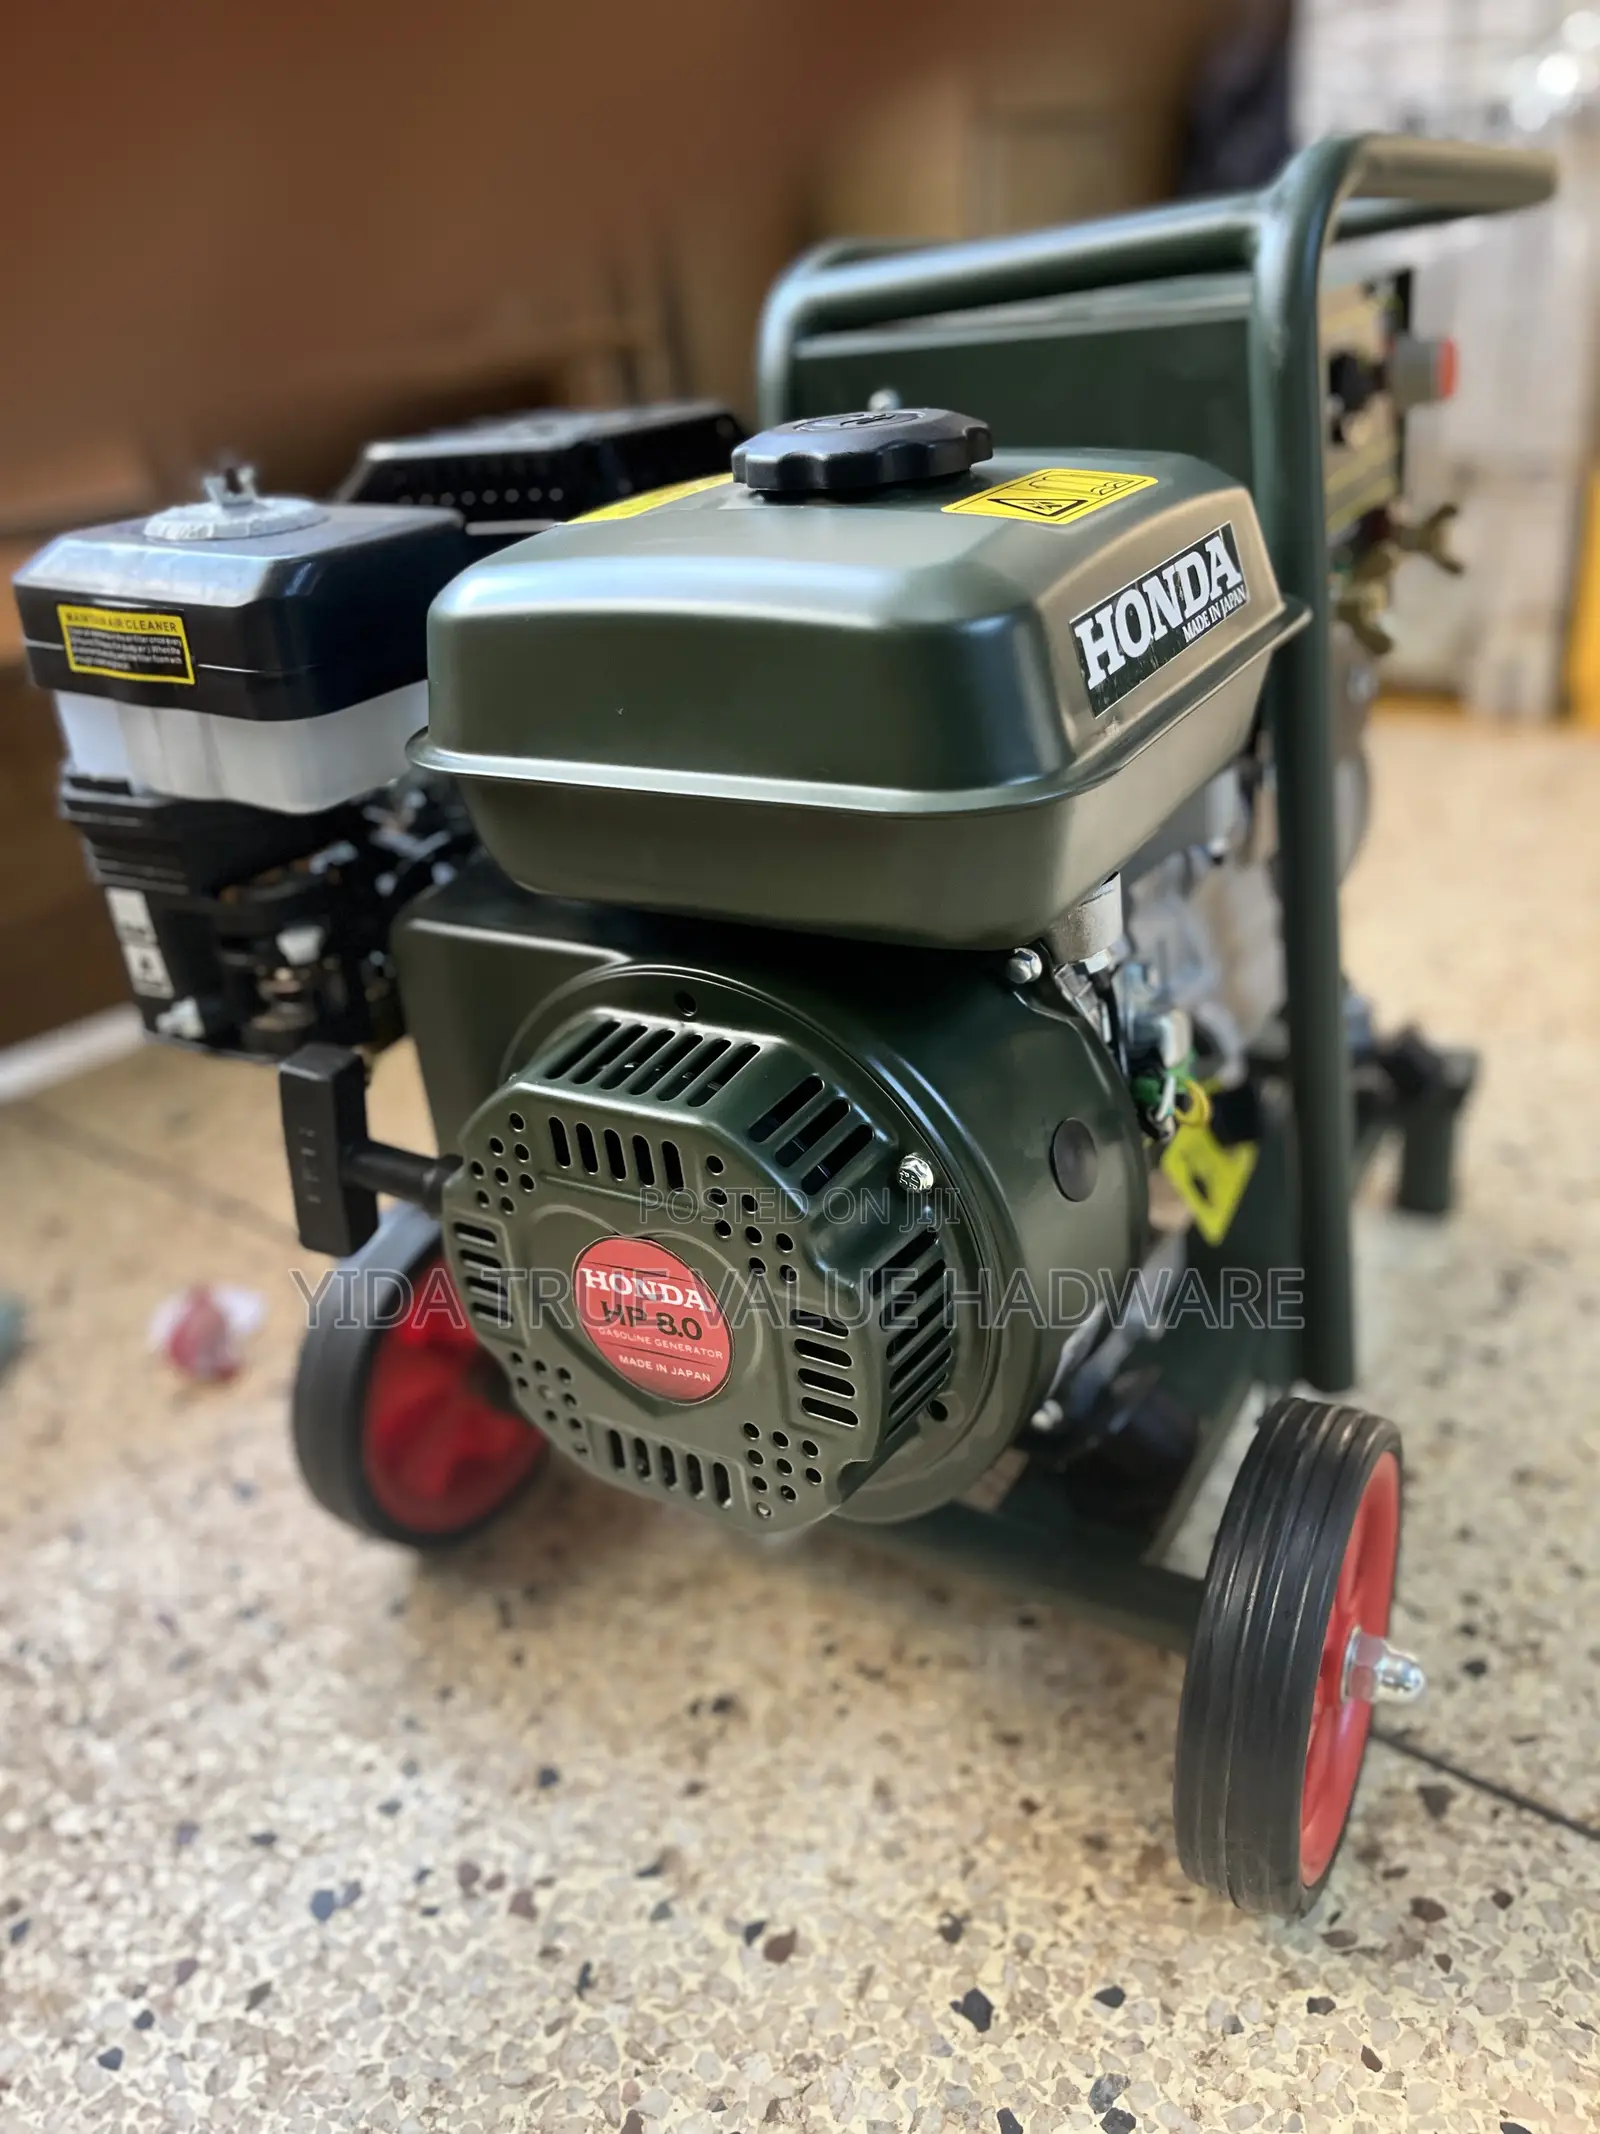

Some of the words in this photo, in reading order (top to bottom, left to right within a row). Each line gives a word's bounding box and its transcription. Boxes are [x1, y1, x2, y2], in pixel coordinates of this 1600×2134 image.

[125, 619, 178, 633] CLEANER
[1074, 535, 1243, 691] HONDA
[1181, 617, 1209, 642] MADE
[1208, 604, 1222, 624] IN
[1219, 585, 1247, 618] JAPAN
[580, 1267, 712, 1313] HONDA
[600, 1300, 648, 1328] HP
[655, 1311, 703, 1341] 8.0
[598, 1327, 652, 1346] GASOLINE
[654, 1338, 723, 1360] GENERATOR
[618, 1354, 653, 1370] MADE
[656, 1363, 668, 1374] IN
[671, 1366, 711, 1383] JAPAN
